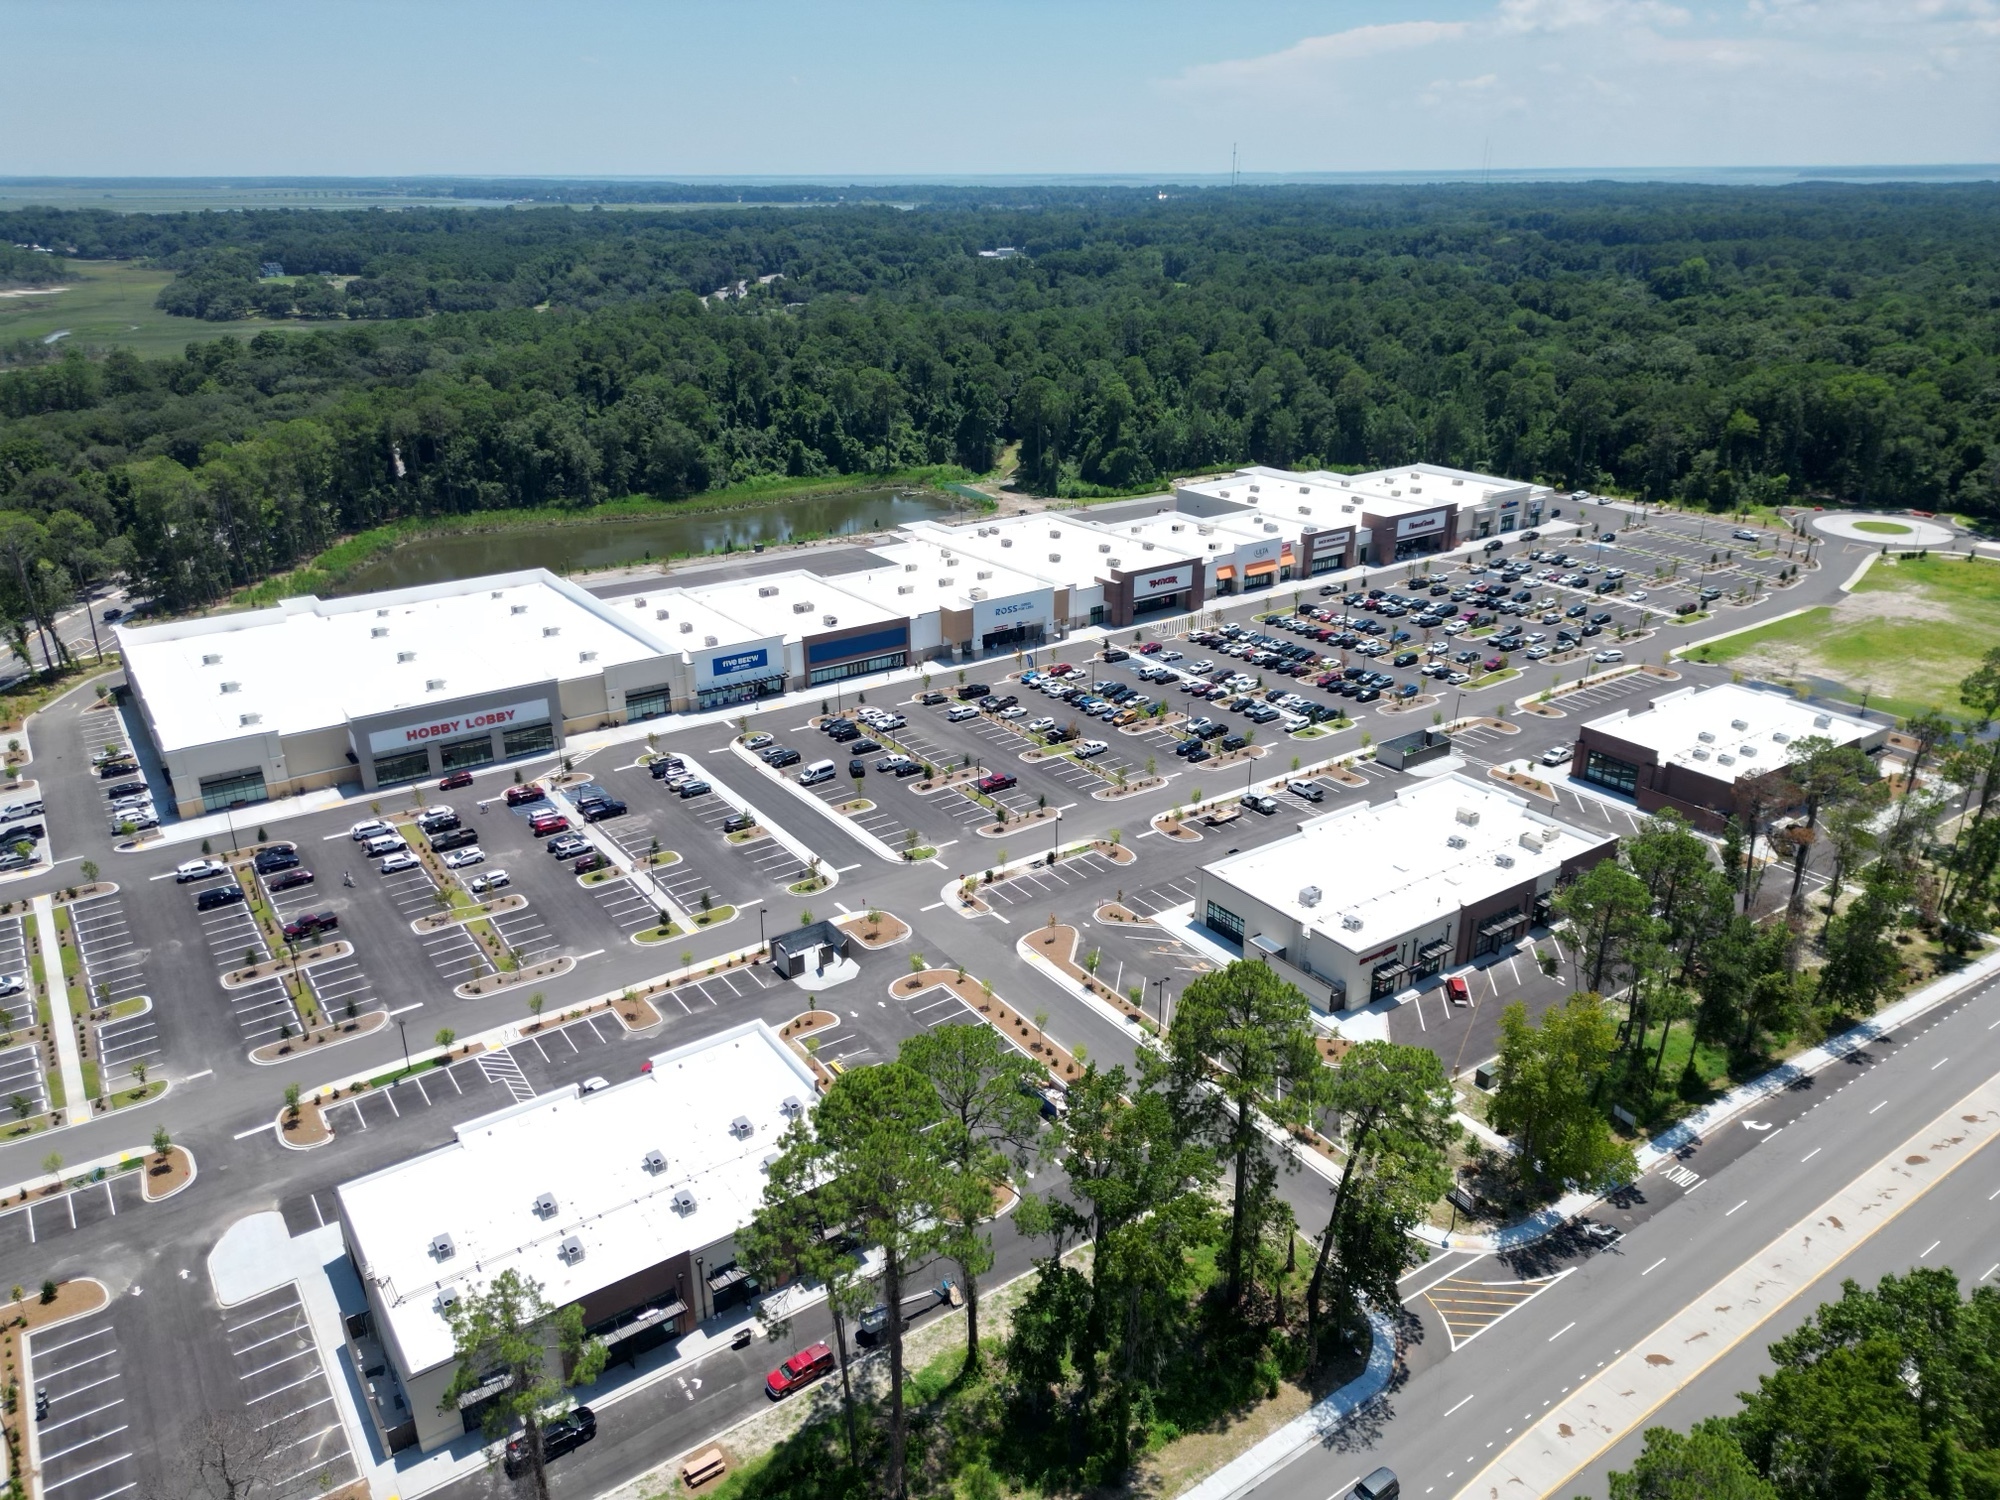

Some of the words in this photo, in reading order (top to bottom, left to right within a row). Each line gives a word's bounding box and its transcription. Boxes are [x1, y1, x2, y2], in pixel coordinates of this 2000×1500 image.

[995, 604, 1018, 616] ROSS
[406, 721, 460, 741] HOBBY
[465, 709, 515, 729] LOBBY
[1659, 1164, 1700, 1187] ONLY
